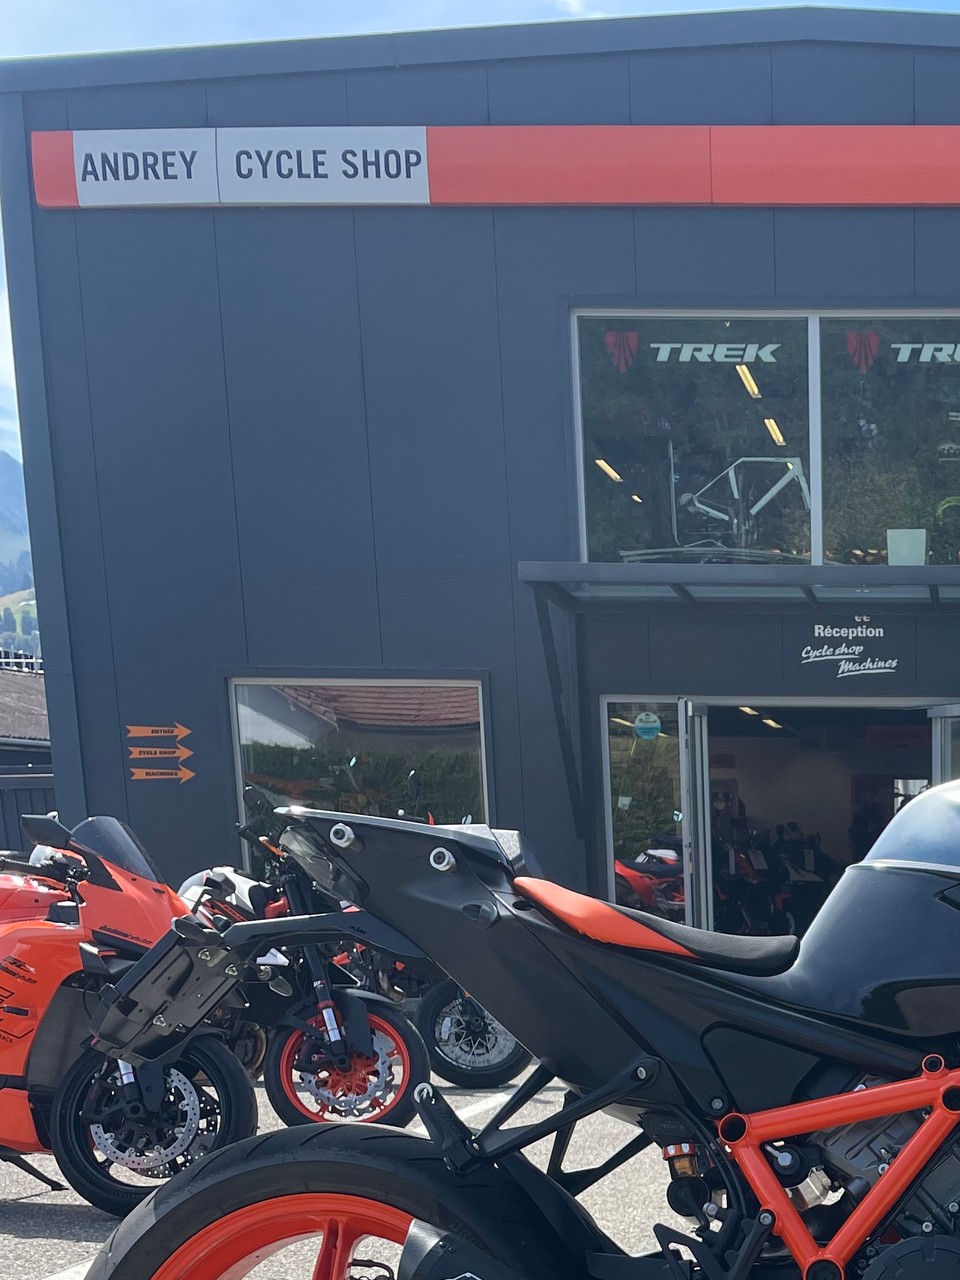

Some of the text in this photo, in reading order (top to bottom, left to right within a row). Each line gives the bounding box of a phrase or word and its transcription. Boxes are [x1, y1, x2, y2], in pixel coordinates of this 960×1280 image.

[81, 149, 422, 182] ANDREY CYCLE SHOP
[649, 343, 782, 362] TREK
[814, 624, 884, 640] Réception
[838, 657, 898, 674] Machines
